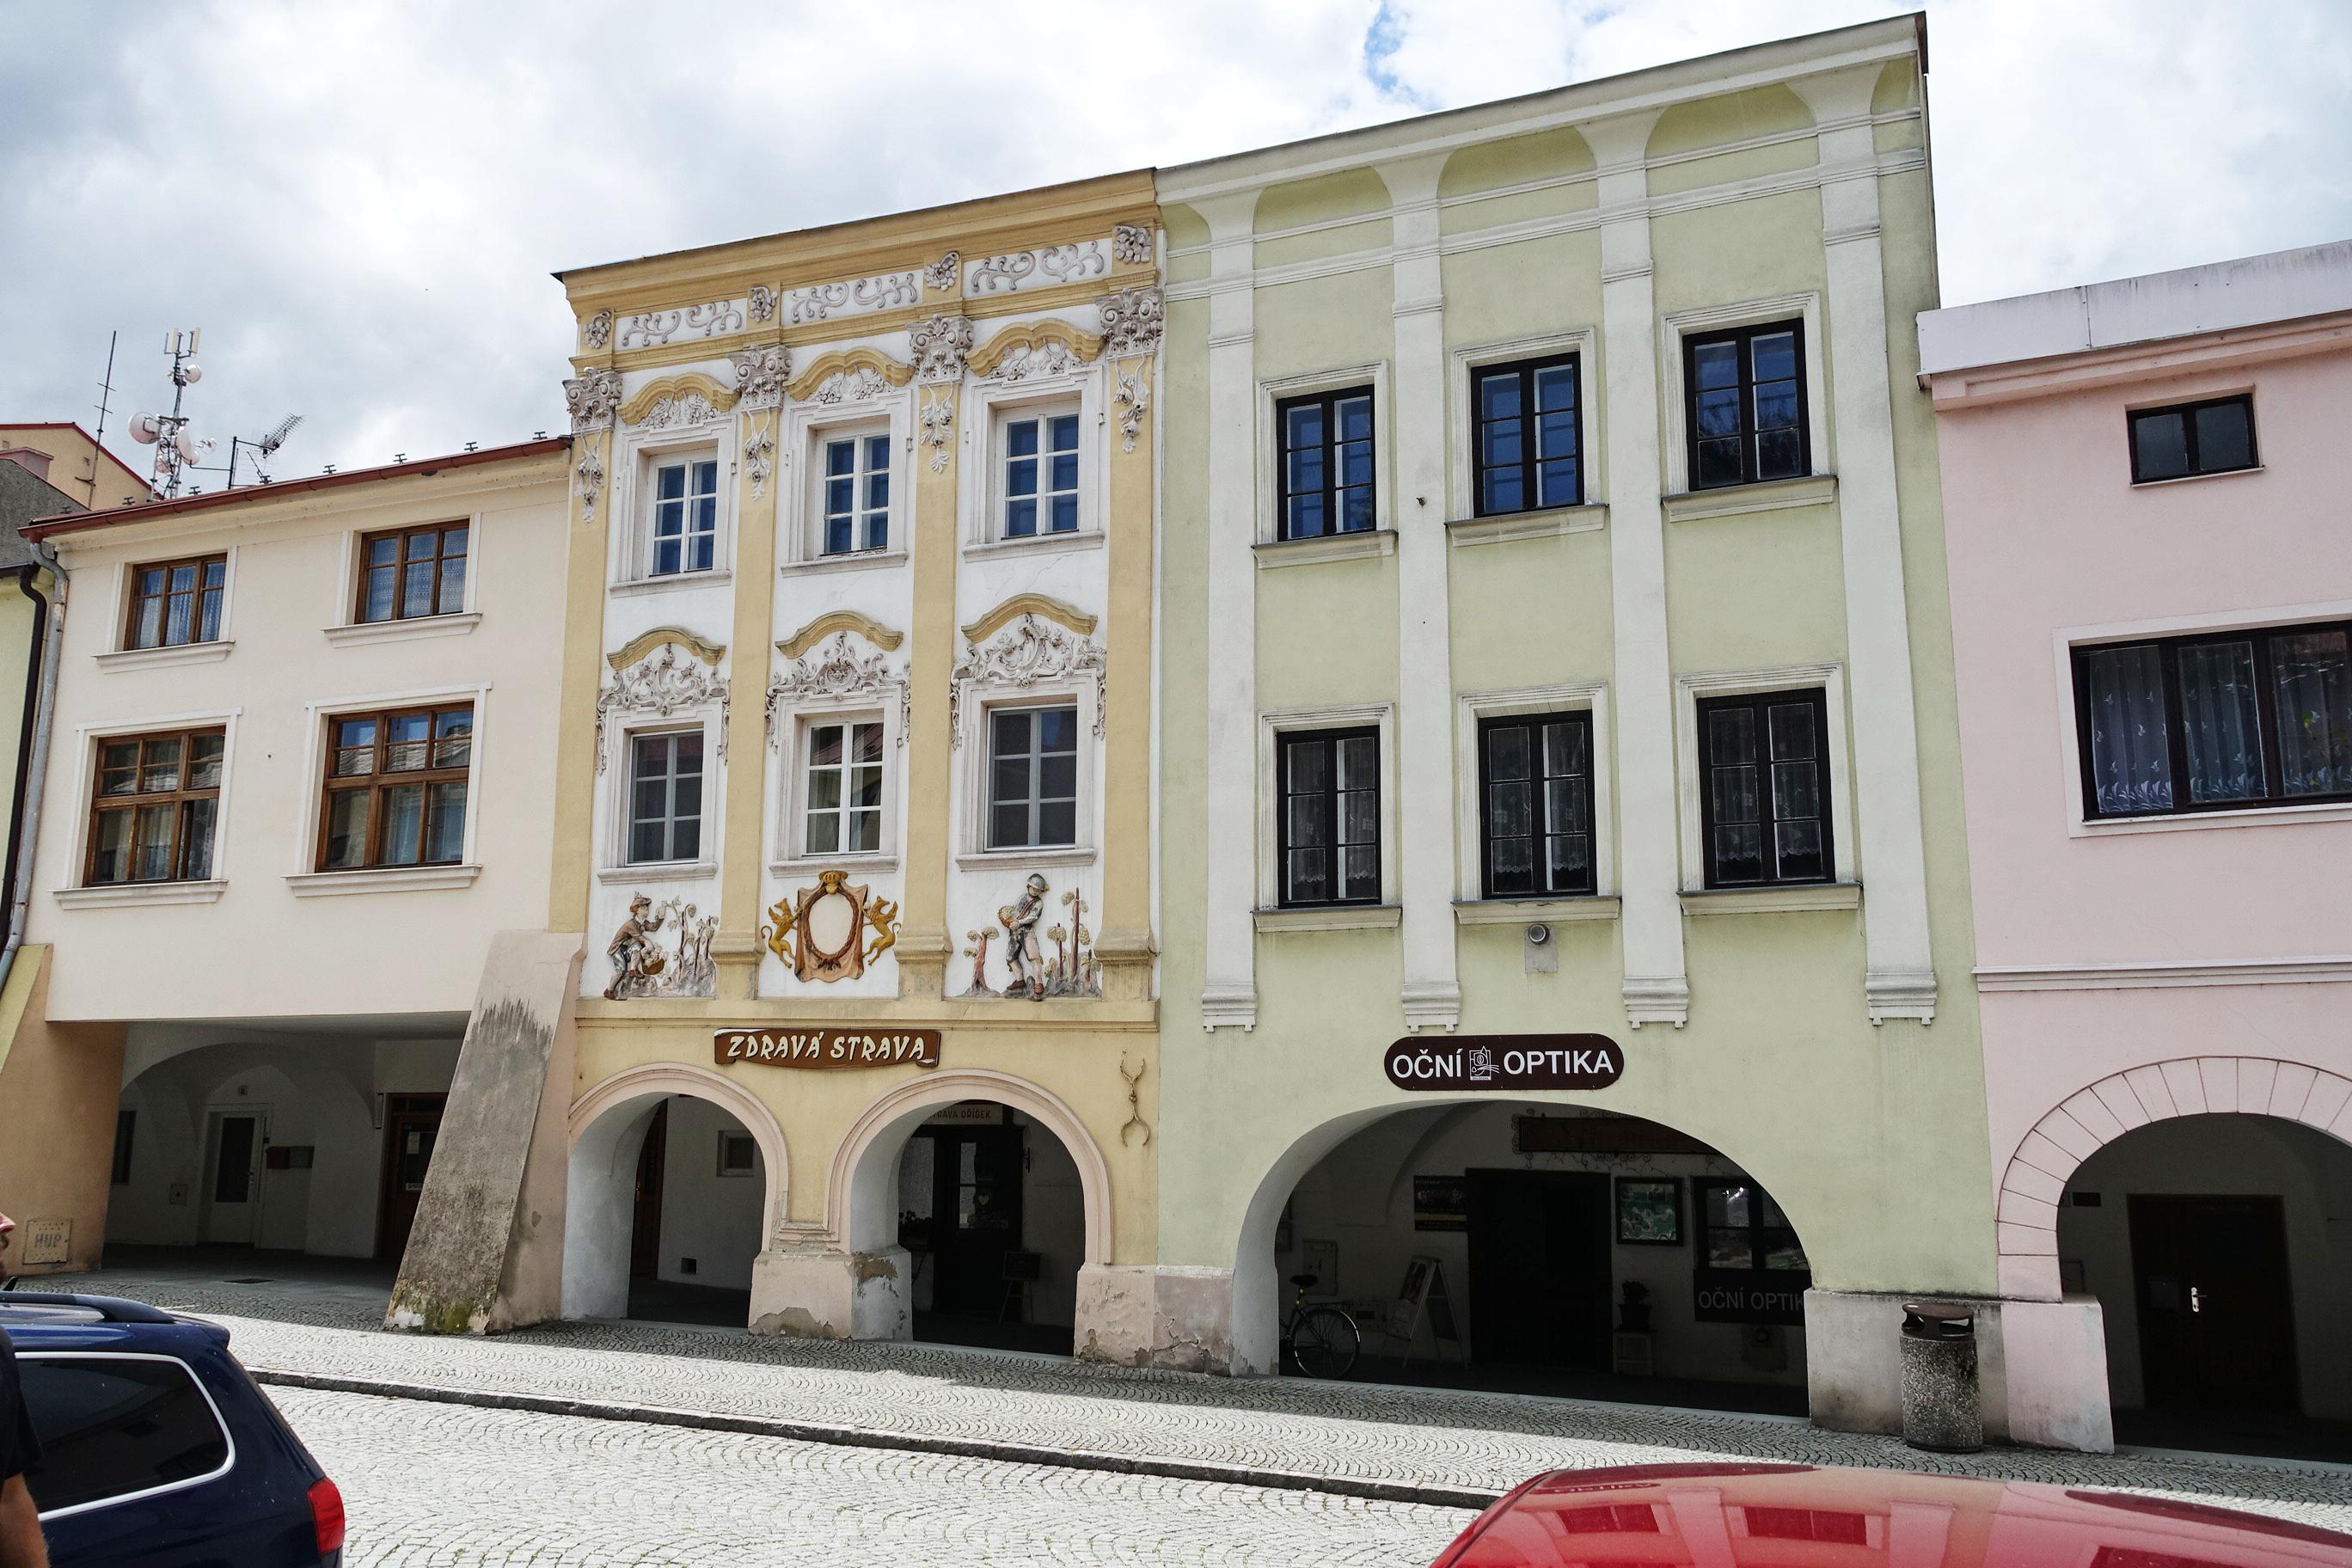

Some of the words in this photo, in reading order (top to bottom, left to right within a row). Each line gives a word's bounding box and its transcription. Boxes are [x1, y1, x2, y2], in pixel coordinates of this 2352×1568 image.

[727, 1032, 825, 1061] ZDRAVÁ
[830, 1036, 926, 1062] STRAVA
[1393, 1048, 1463, 1079] OČNÍ
[1504, 1050, 1614, 1075] OPTIKA
[1698, 1286, 1746, 1309] OČNÍ
